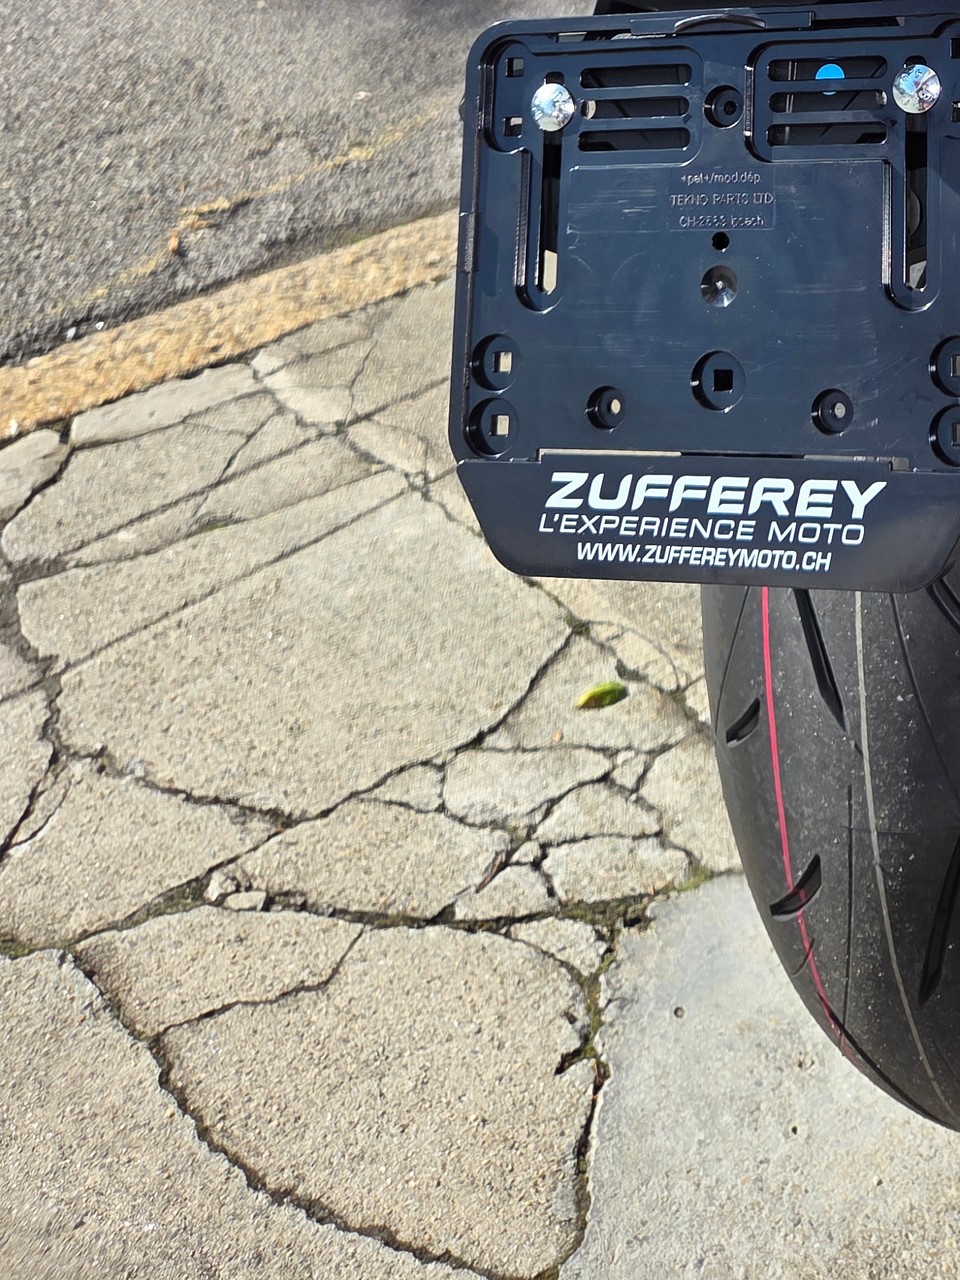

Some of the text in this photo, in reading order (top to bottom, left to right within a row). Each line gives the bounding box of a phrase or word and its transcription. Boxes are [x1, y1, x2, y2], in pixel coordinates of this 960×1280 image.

[670, 192, 774, 206] TEKNO PARTS LTD
[544, 472, 888, 520] ZUFFEREY
[538, 513, 866, 546] L'EXPERIENCE MOTO
[576, 541, 833, 573] WWW.ZUFFEREYMOTO.CH
